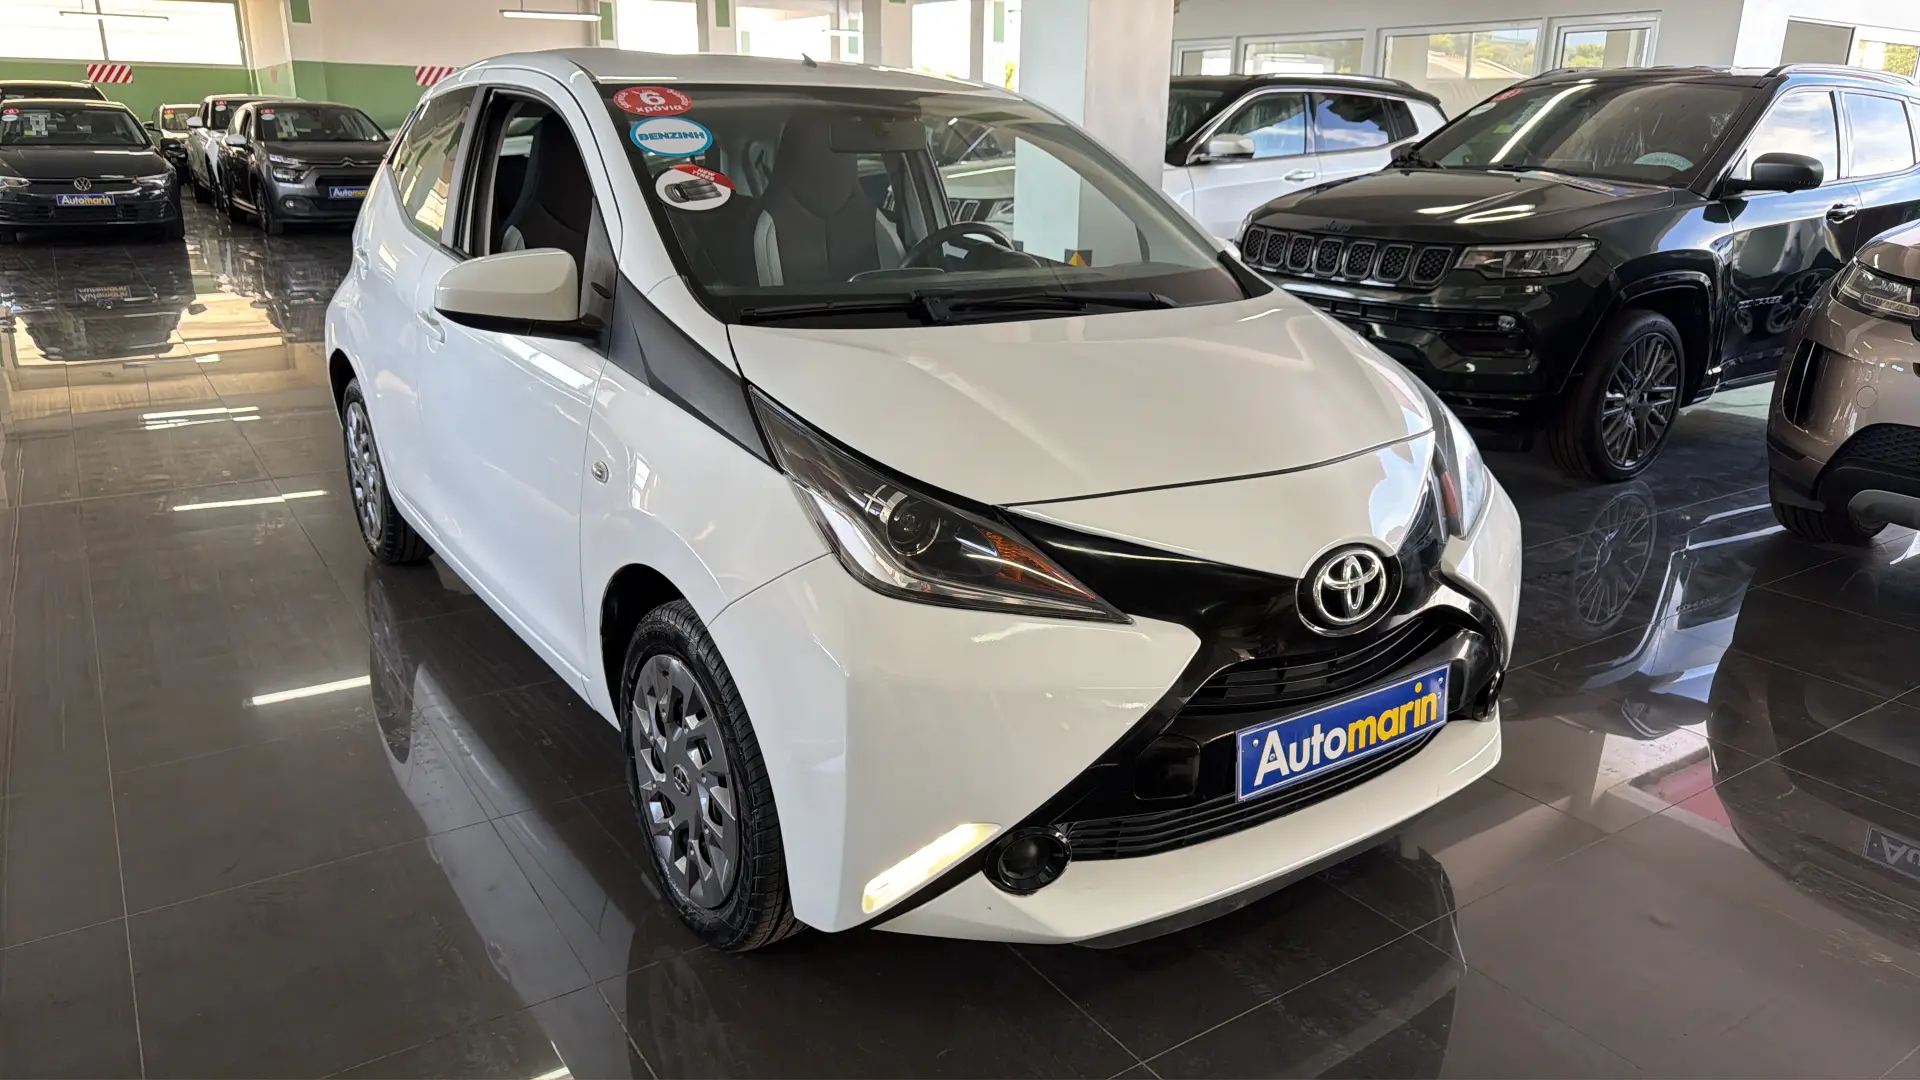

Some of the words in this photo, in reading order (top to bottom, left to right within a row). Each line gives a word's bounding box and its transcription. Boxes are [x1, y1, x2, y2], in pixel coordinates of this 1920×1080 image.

[640, 91, 666, 105] 6
[636, 105, 683, 113] χρόνια
[333, 187, 367, 197] Automa
[61, 195, 111, 205] Automarin
[1253, 682, 1437, 787] Automarin
